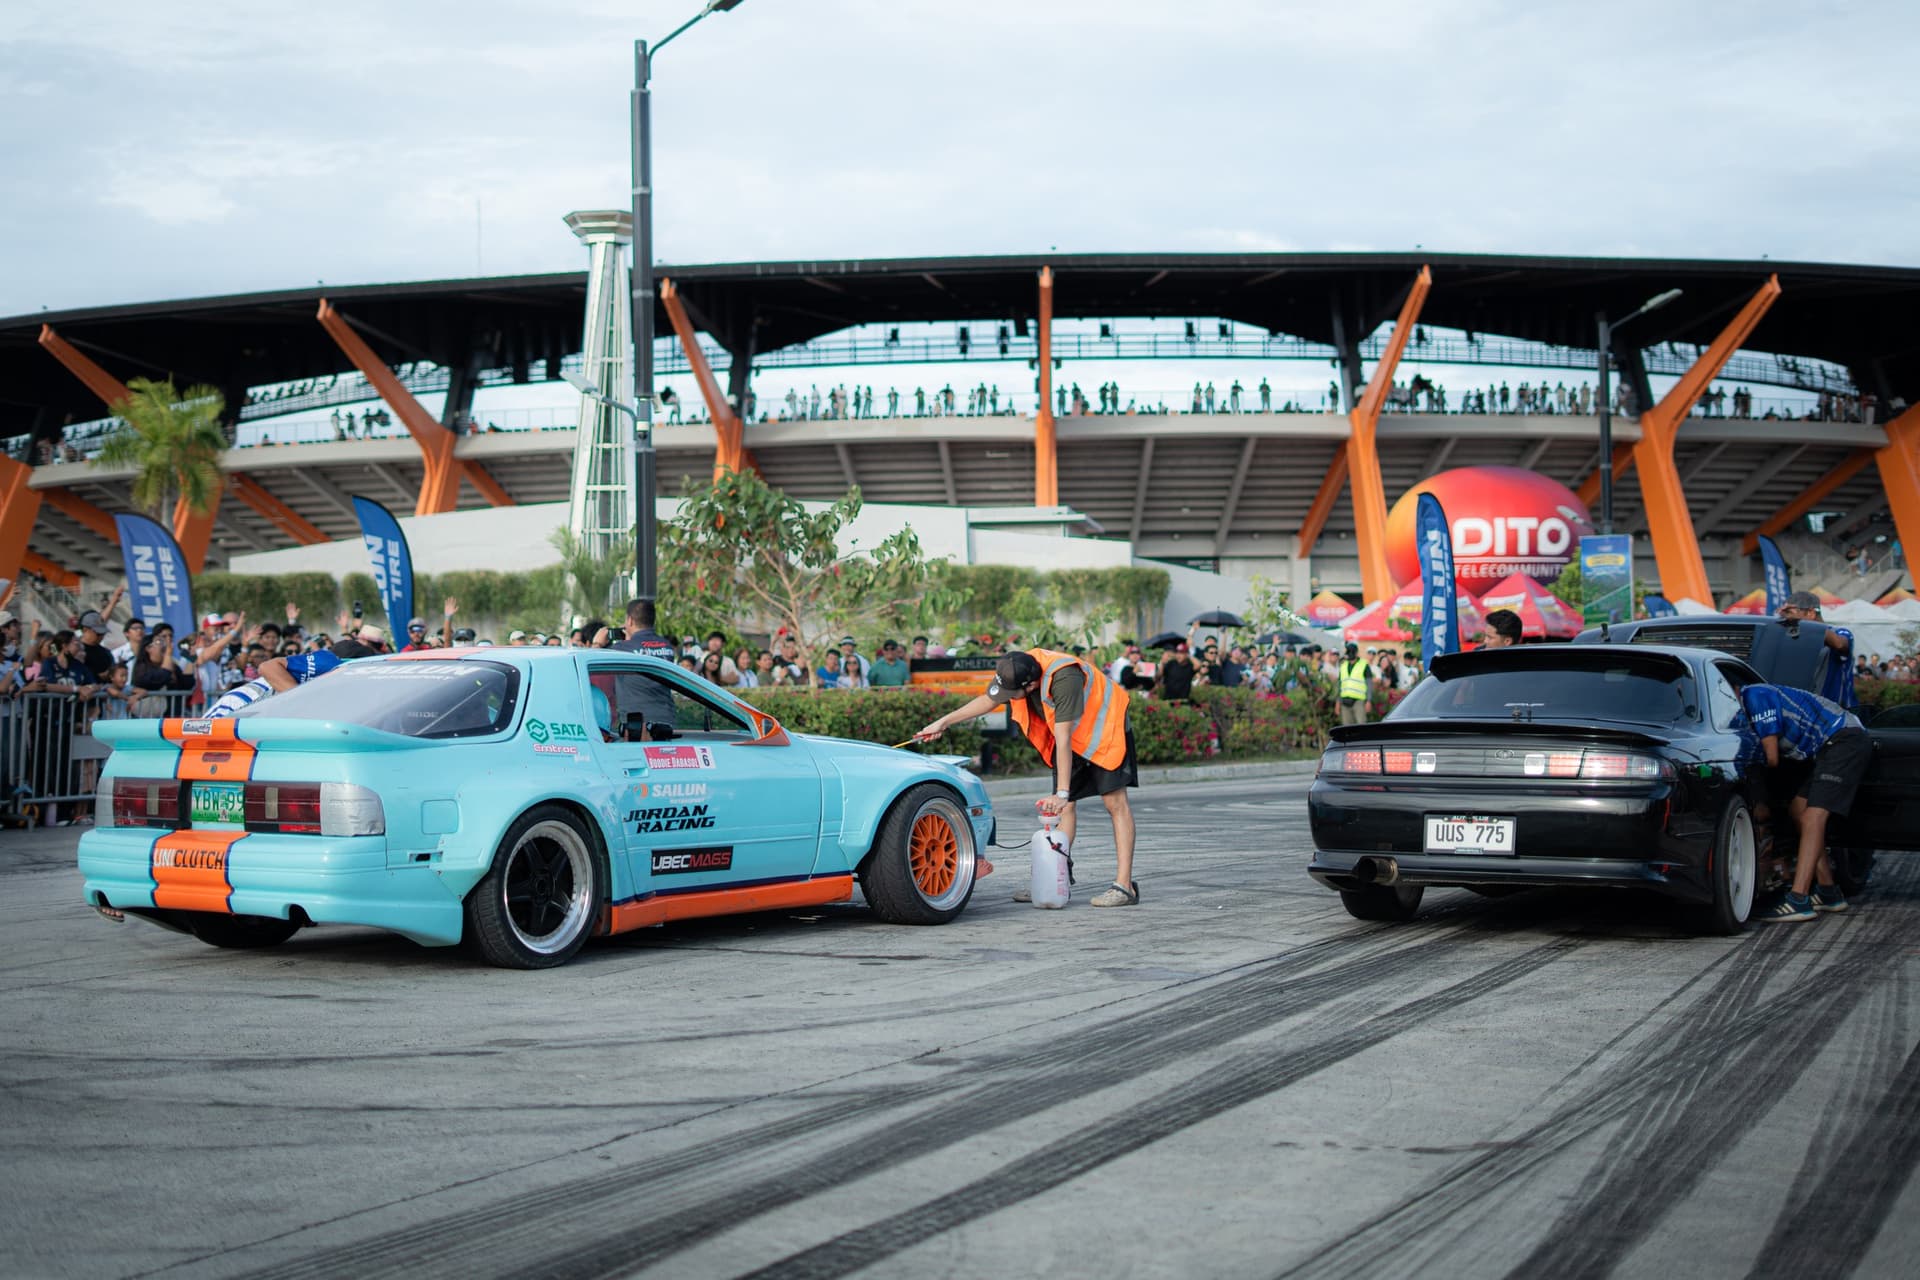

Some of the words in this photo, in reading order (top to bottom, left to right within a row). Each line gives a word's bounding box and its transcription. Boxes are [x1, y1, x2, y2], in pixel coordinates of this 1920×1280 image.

[1453, 516, 1570, 556] DITO
[157, 546, 180, 607] TIRE
[387, 539, 402, 602] TIRE
[1453, 563, 1566, 579] TELECOMMUNIT
[132, 545, 164, 628] ILUN
[1426, 530, 1448, 657] AILUN
[550, 722, 587, 736] SATA
[702, 754, 711, 767] 6
[194, 790, 220, 811] YBW
[226, 791, 244, 812] 99
[652, 784, 706, 797] SAILUN
[623, 804, 708, 822] JORDAN
[636, 816, 716, 834] RACING
[1435, 824, 1465, 842] UUS
[1475, 825, 1505, 844] 775
[152, 847, 225, 870] UNICLUTCH
